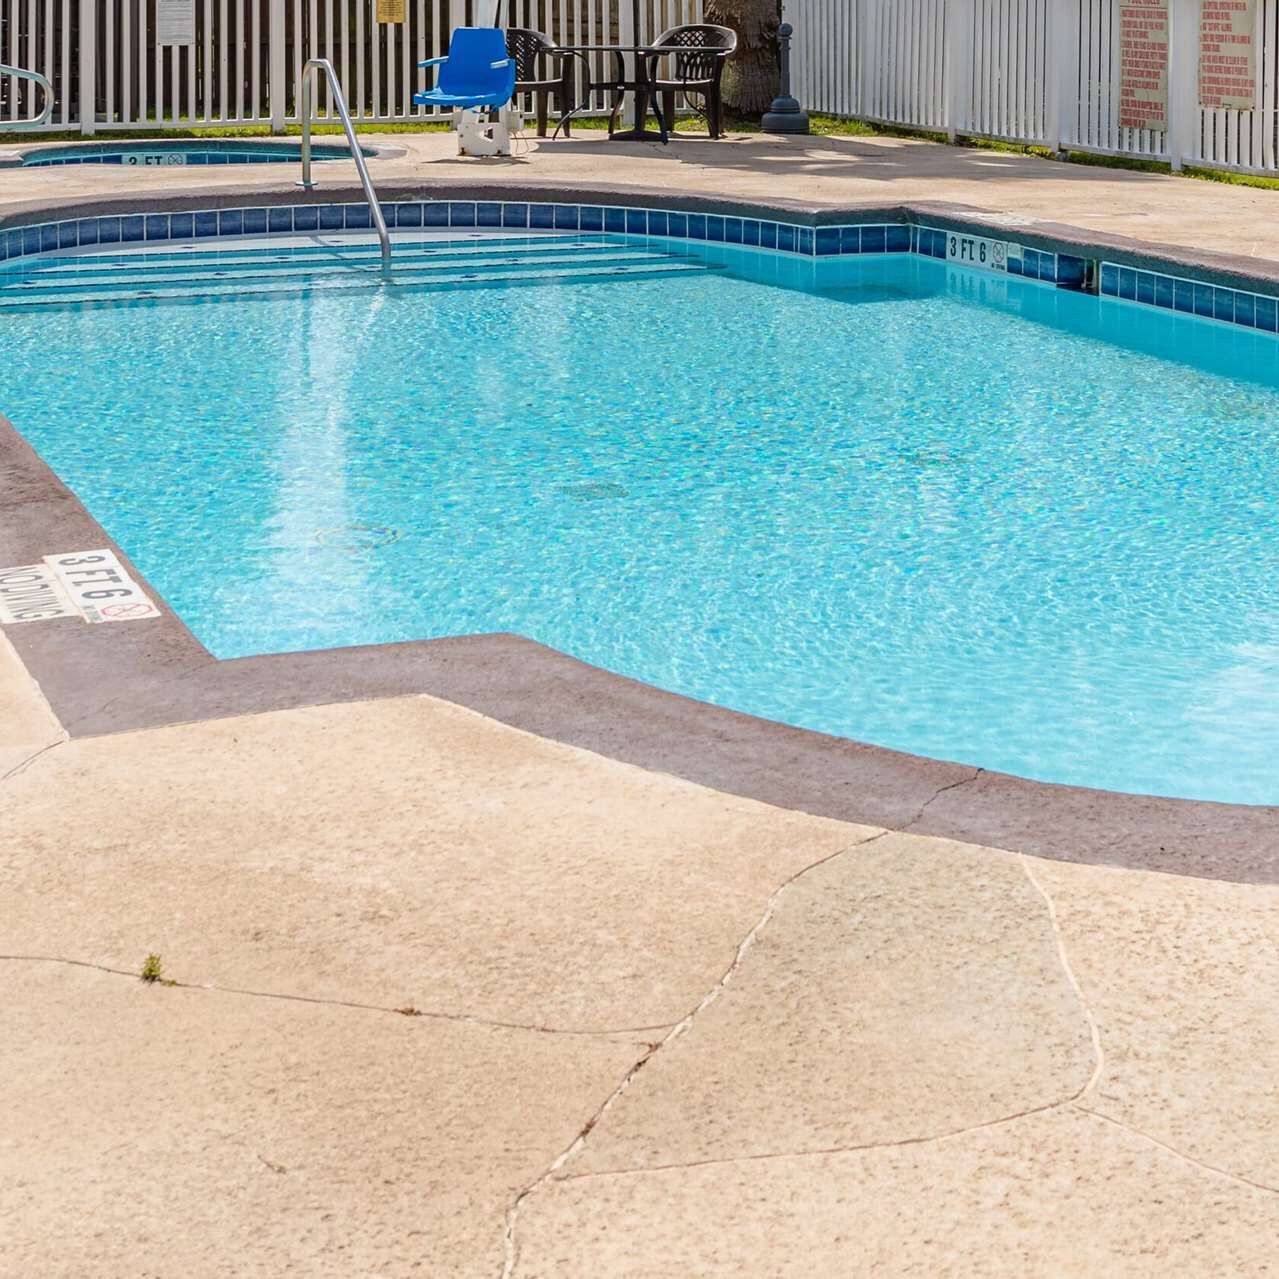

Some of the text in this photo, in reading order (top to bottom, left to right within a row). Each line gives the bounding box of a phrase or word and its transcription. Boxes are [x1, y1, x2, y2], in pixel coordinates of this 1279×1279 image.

[950, 236, 957, 257] 3
[979, 242, 986, 263] 6
[58, 554, 106, 566] 3
[81, 587, 134, 600] 6
